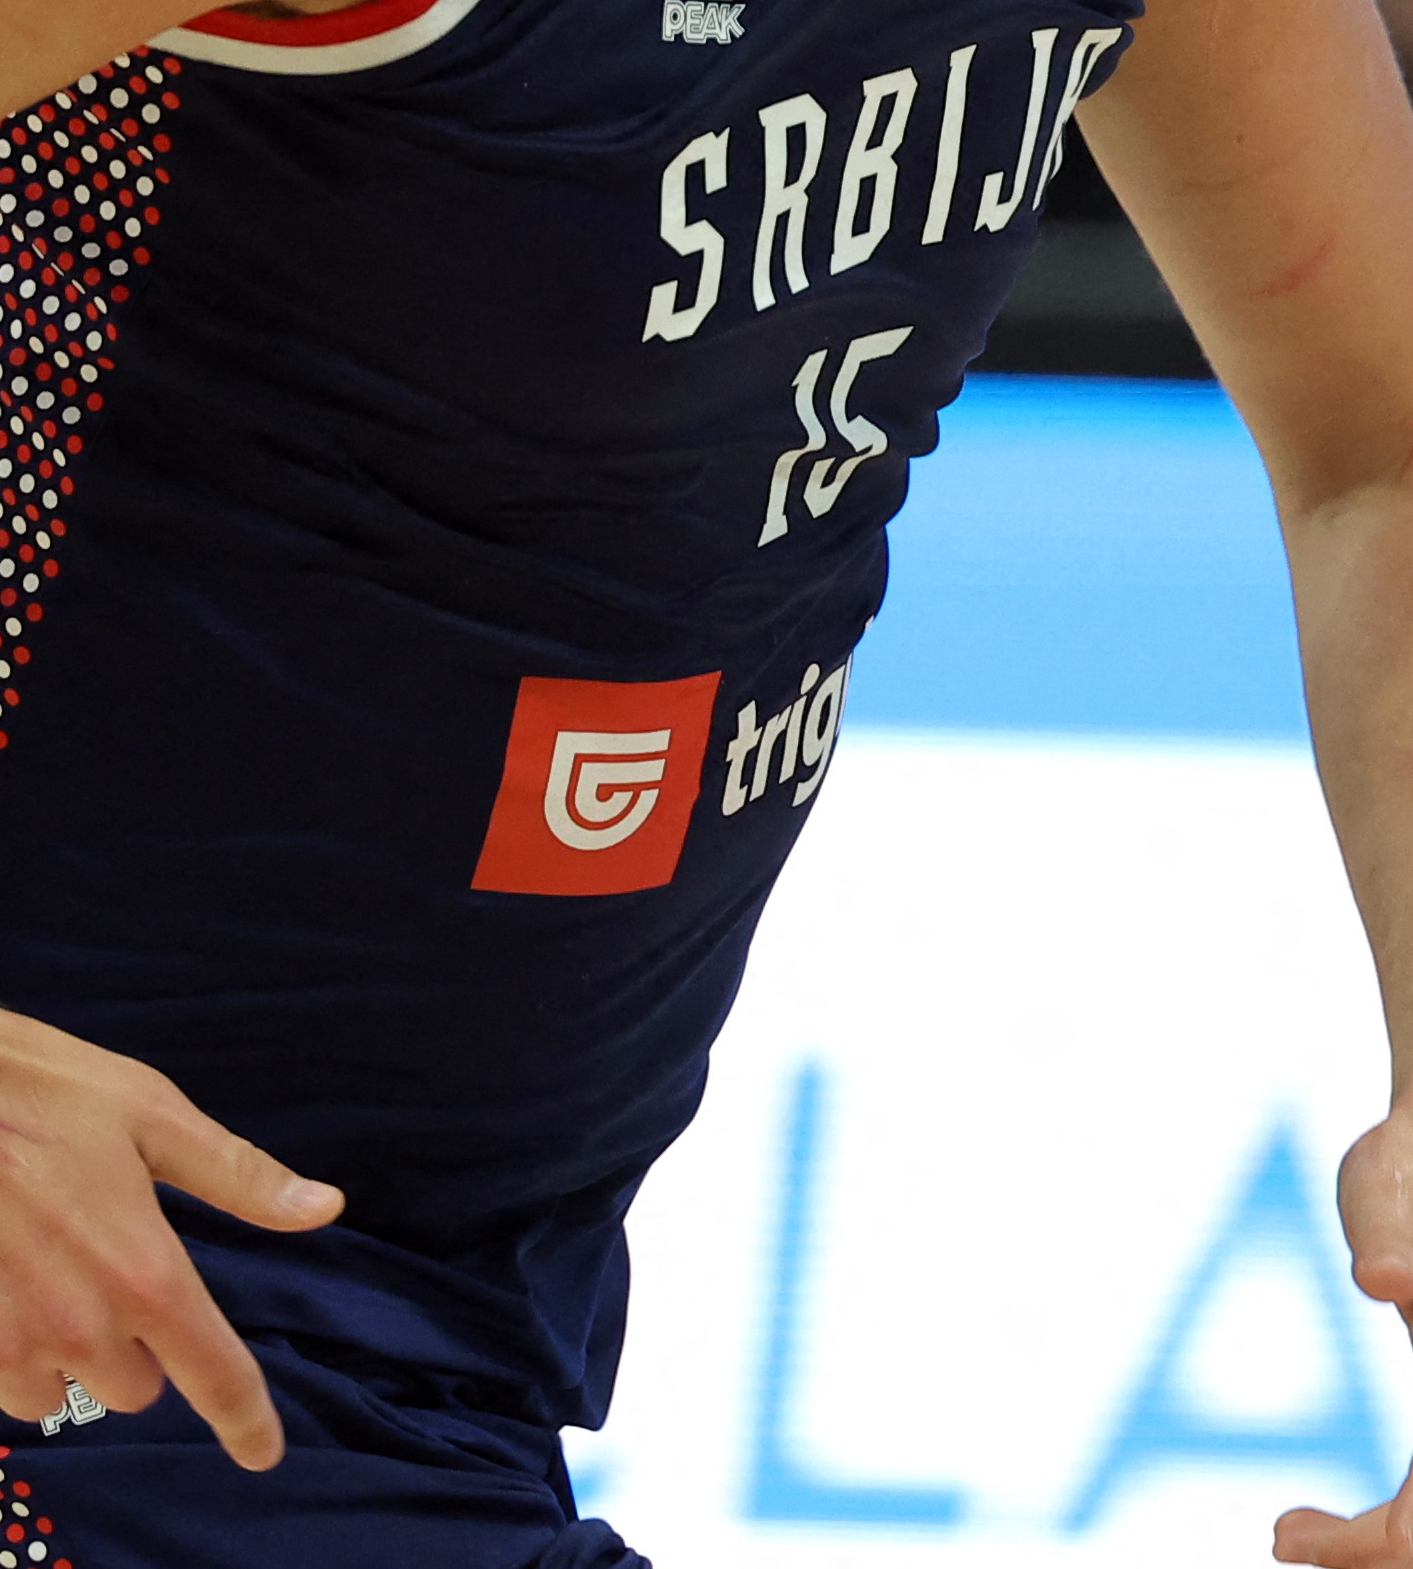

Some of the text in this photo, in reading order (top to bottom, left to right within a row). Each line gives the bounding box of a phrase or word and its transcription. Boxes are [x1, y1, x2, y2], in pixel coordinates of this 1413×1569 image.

[757, 325, 915, 548] 15
[721, 652, 853, 817] trig
[567, 1048, 1399, 1538] LA
